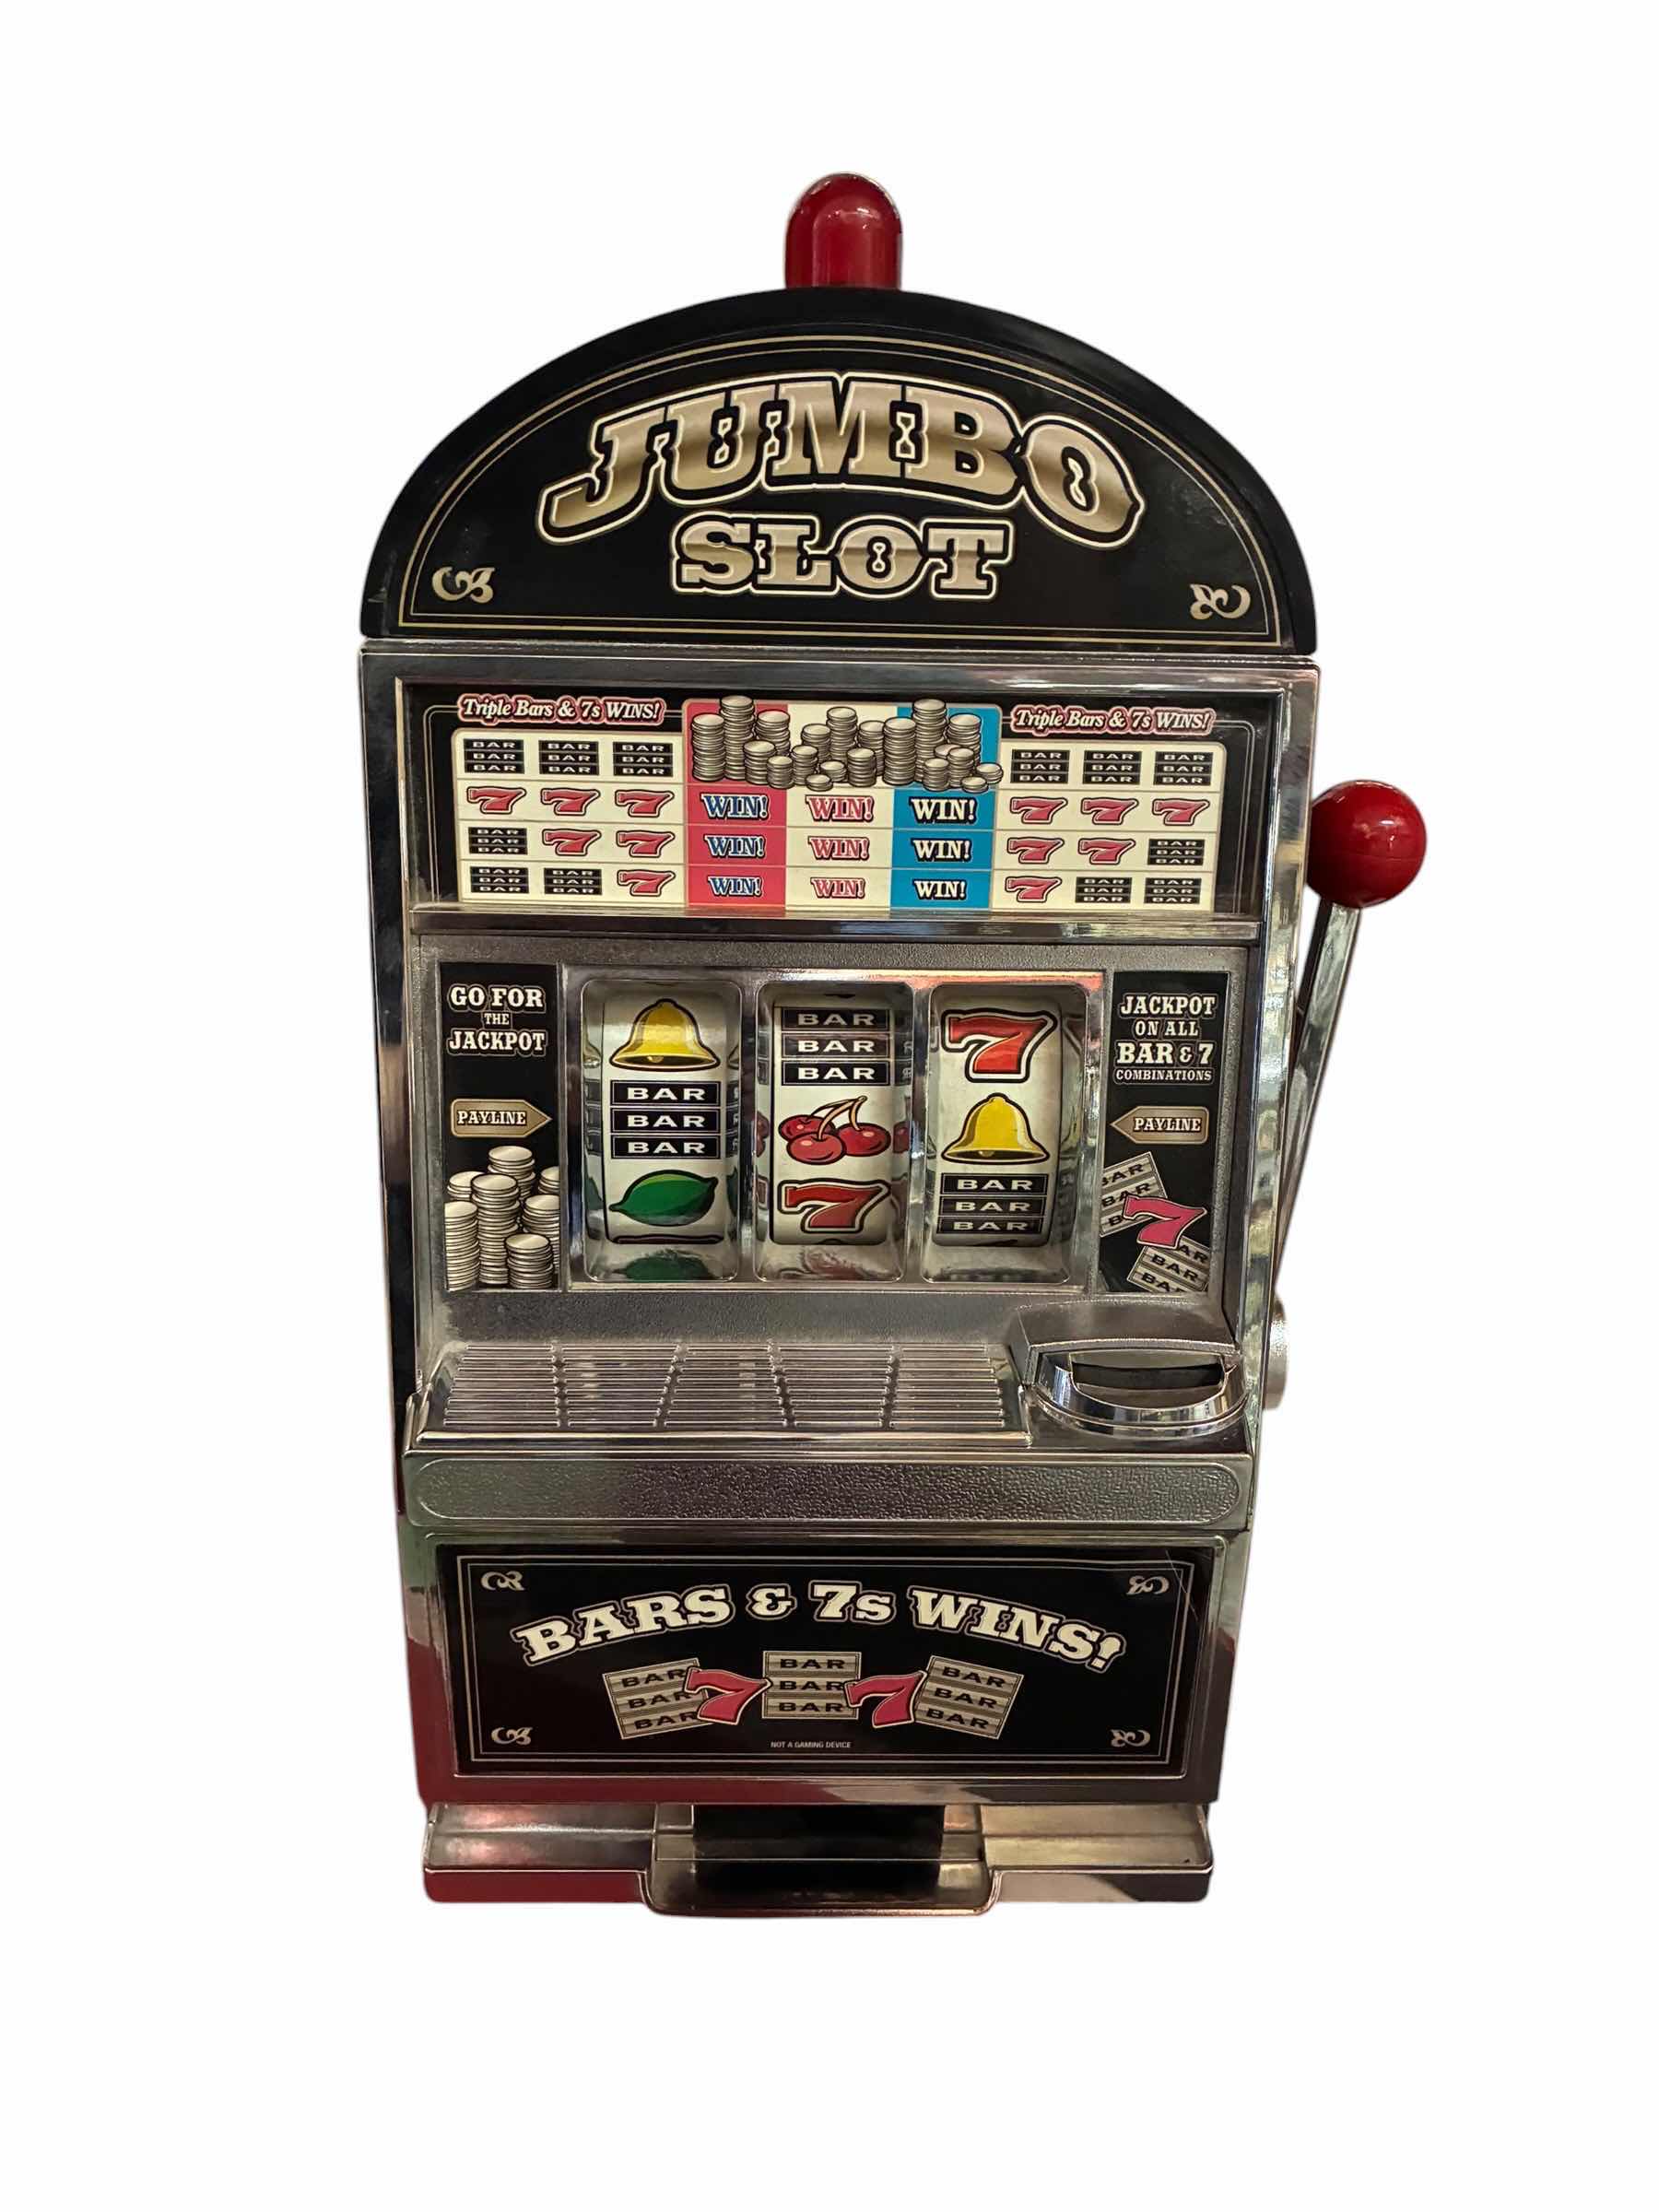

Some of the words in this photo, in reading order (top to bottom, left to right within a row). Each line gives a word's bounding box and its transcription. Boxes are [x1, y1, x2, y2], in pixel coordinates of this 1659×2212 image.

[542, 372, 1144, 546] JUMBO
[673, 513, 1013, 600] SLOT
[463, 698, 511, 722] Triple
[515, 700, 553, 716] Bars
[558, 700, 575, 716] &
[581, 701, 600, 717] 7s
[605, 702, 660, 719] WINS!
[1015, 710, 1064, 730] Triple
[1065, 712, 1104, 727] Bars
[1109, 712, 1124, 727] &
[1132, 714, 1151, 728] 7s
[1157, 714, 1212, 729] WINS!
[466, 786, 526, 814] 7
[540, 788, 601, 816] 7
[615, 790, 674, 818] 7
[701, 794, 768, 819] WIN!
[806, 796, 875, 821] WIN!
[910, 797, 976, 823] WIN!
[1010, 796, 1068, 825] 7
[1081, 797, 1138, 825] 7
[1152, 798, 1210, 826] 7
[542, 829, 601, 856] 7
[616, 830, 675, 858] 7
[705, 835, 765, 858] WIN!
[808, 836, 869, 860] WIN!
[912, 839, 971, 862] WIN!
[1007, 837, 1064, 864] 7
[1078, 838, 1135, 865] 7
[617, 869, 676, 897] 7
[708, 877, 762, 896] WIN!
[811, 877, 865, 899] WIN!
[913, 880, 967, 900] WIN!
[1005, 876, 1062, 902] 7
[450, 986, 486, 1007] GO
[490, 987, 544, 1008] FOR
[1121, 995, 1217, 1015] JACKPOT
[484, 1013, 510, 1025] THE
[797, 1014, 875, 1025] BAR
[1135, 1021, 1159, 1036] ON
[1164, 1021, 1199, 1036] ALL
[449, 1032, 546, 1052] JACKPOT
[797, 1041, 875, 1053] BAR
[941, 1008, 1058, 1083] 7
[1116, 1042, 1174, 1064] BAR
[1180, 1046, 1193, 1064] &
[1199, 1044, 1214, 1064] 7
[797, 1067, 875, 1079] BAR
[1115, 1069, 1213, 1081] COMBINATIONS
[627, 1088, 706, 1100] BAR
[457, 1111, 527, 1125] PAYLINE
[628, 1115, 706, 1127] BAR
[1135, 1118, 1201, 1131] PAYLINE
[628, 1142, 706, 1154] BAR
[957, 1180, 1034, 1190] BAR
[778, 1178, 890, 1233] 7
[955, 1201, 1032, 1212] BAR
[953, 1220, 1030, 1231] BAR
[1123, 1194, 1207, 1249] 7
[1152, 1254, 1198, 1281] BAR
[1141, 1273, 1187, 1291] BA
[515, 1586, 733, 1663] BARS
[749, 1586, 794, 1617] &
[811, 1583, 894, 1621] 7s
[911, 1588, 1124, 1671] WINS!
[780, 1659, 845, 1669] BAR
[779, 1680, 844, 1690] BAR
[942, 1666, 1006, 1688] BAR
[684, 1665, 771, 1725] 7
[843, 1670, 927, 1728] 7
[934, 1688, 998, 1709] BAR
[779, 1702, 844, 1712] BAR
[926, 1709, 990, 1729] BAR
